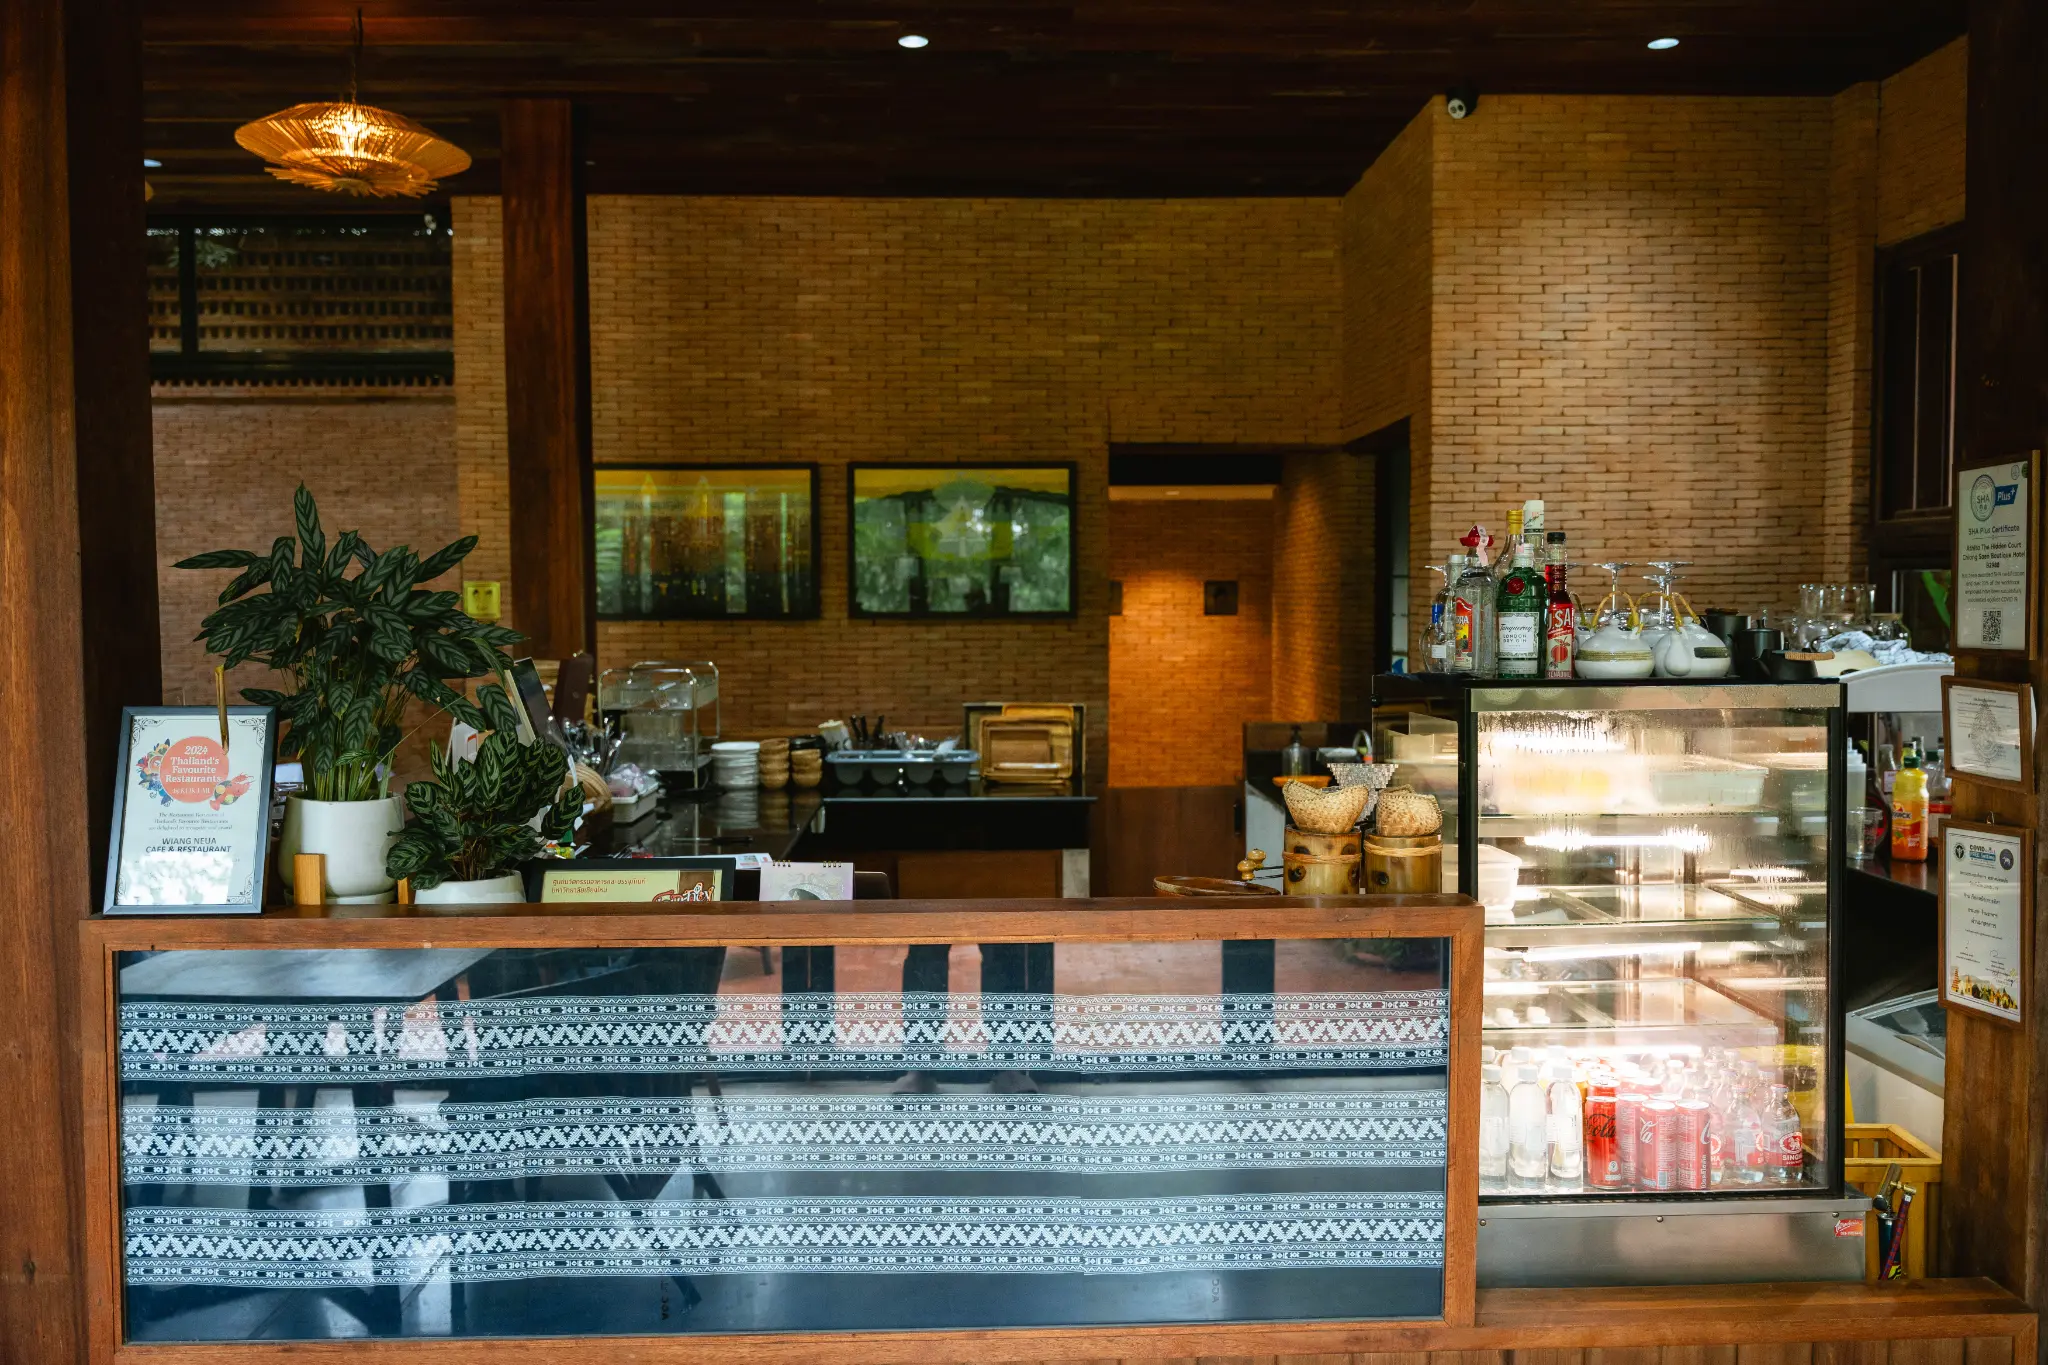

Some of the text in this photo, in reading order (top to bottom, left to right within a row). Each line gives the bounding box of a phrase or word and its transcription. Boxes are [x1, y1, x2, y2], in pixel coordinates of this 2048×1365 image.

[1991, 524, 2020, 533] Certificate
[1990, 542, 2007, 550] Hidden
[2007, 541, 2022, 549] Court
[2012, 550, 2026, 558] Hotel
[184, 745, 209, 755] 2024
[170, 756, 220, 765] Thailand's
[172, 765, 217, 774] Favourite
[165, 774, 222, 783] Restaurants
[162, 837, 217, 845] WIANG NEUA
[177, 845, 232, 853] RESTAURANT
